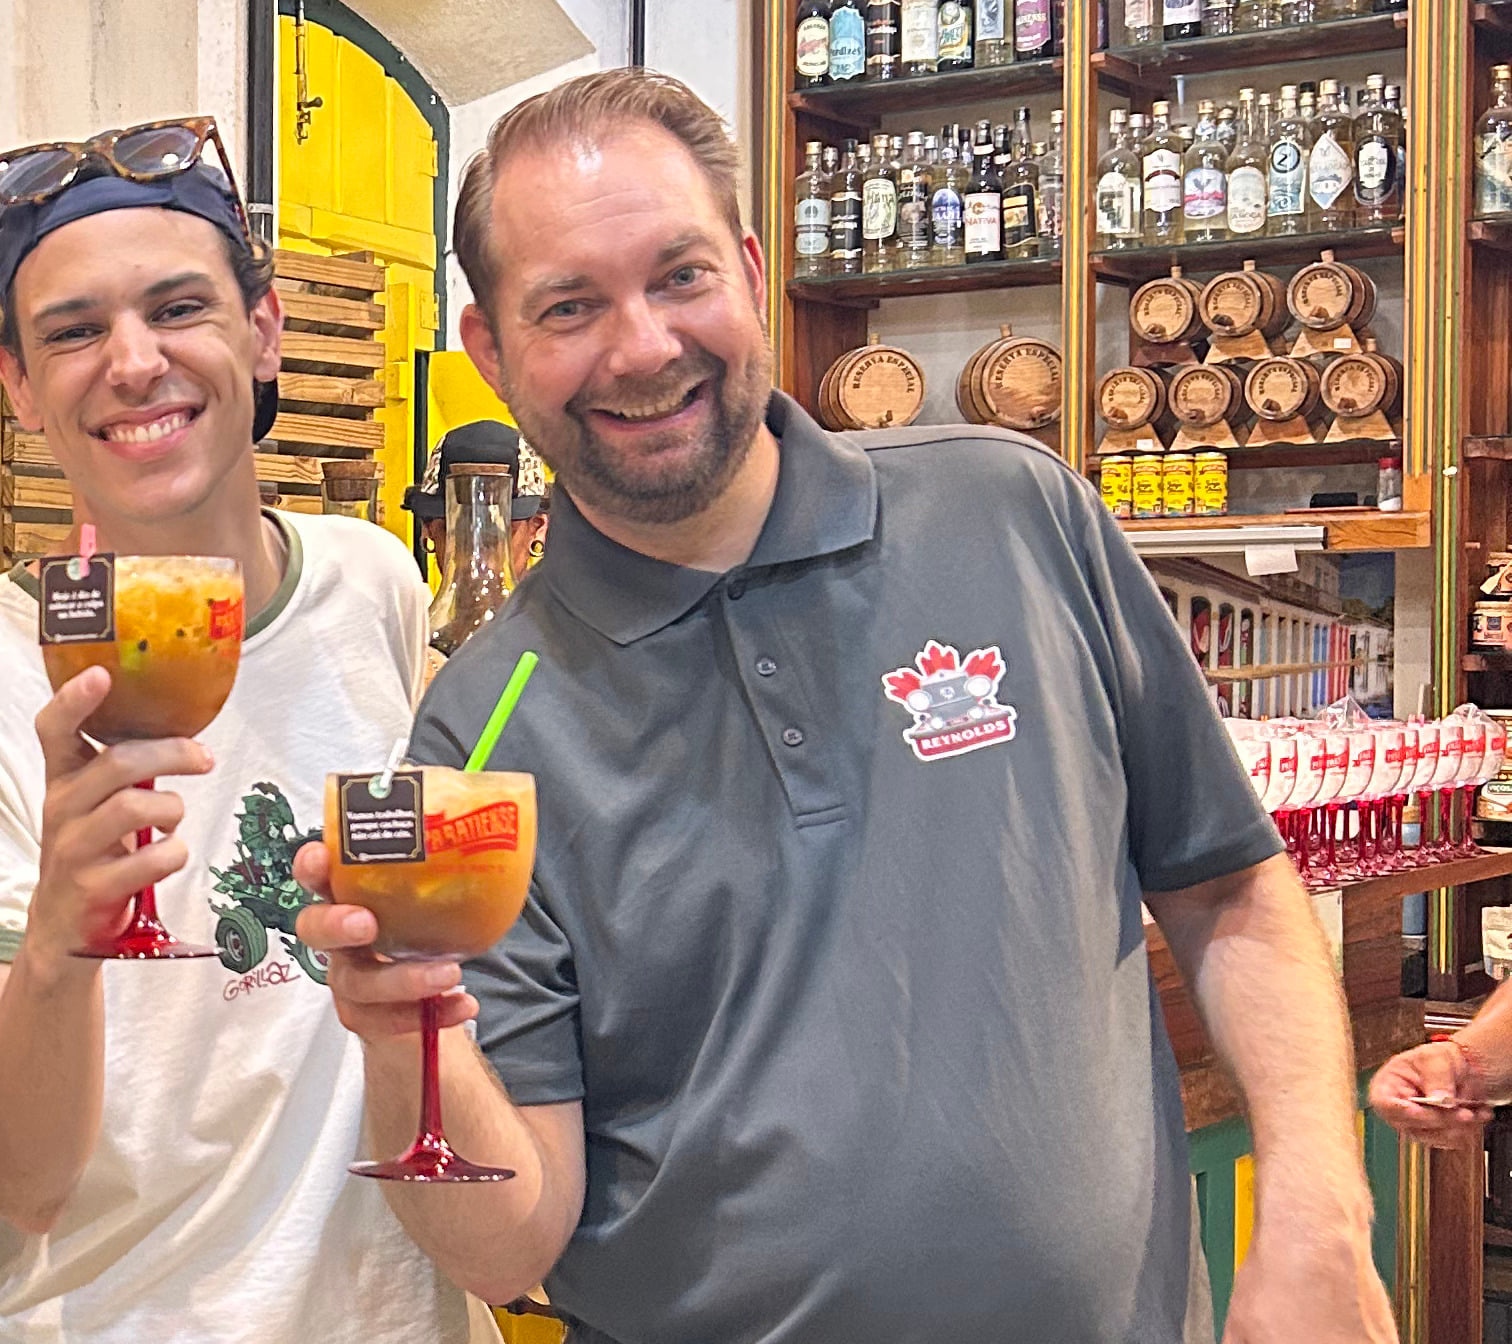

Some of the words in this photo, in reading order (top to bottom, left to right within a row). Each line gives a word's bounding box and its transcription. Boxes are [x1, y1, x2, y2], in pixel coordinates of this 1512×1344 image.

[853, 355, 885, 390] RESERVA
[886, 355, 915, 393] ESPECIAL
[920, 720, 1007, 751] REYNOLDS
